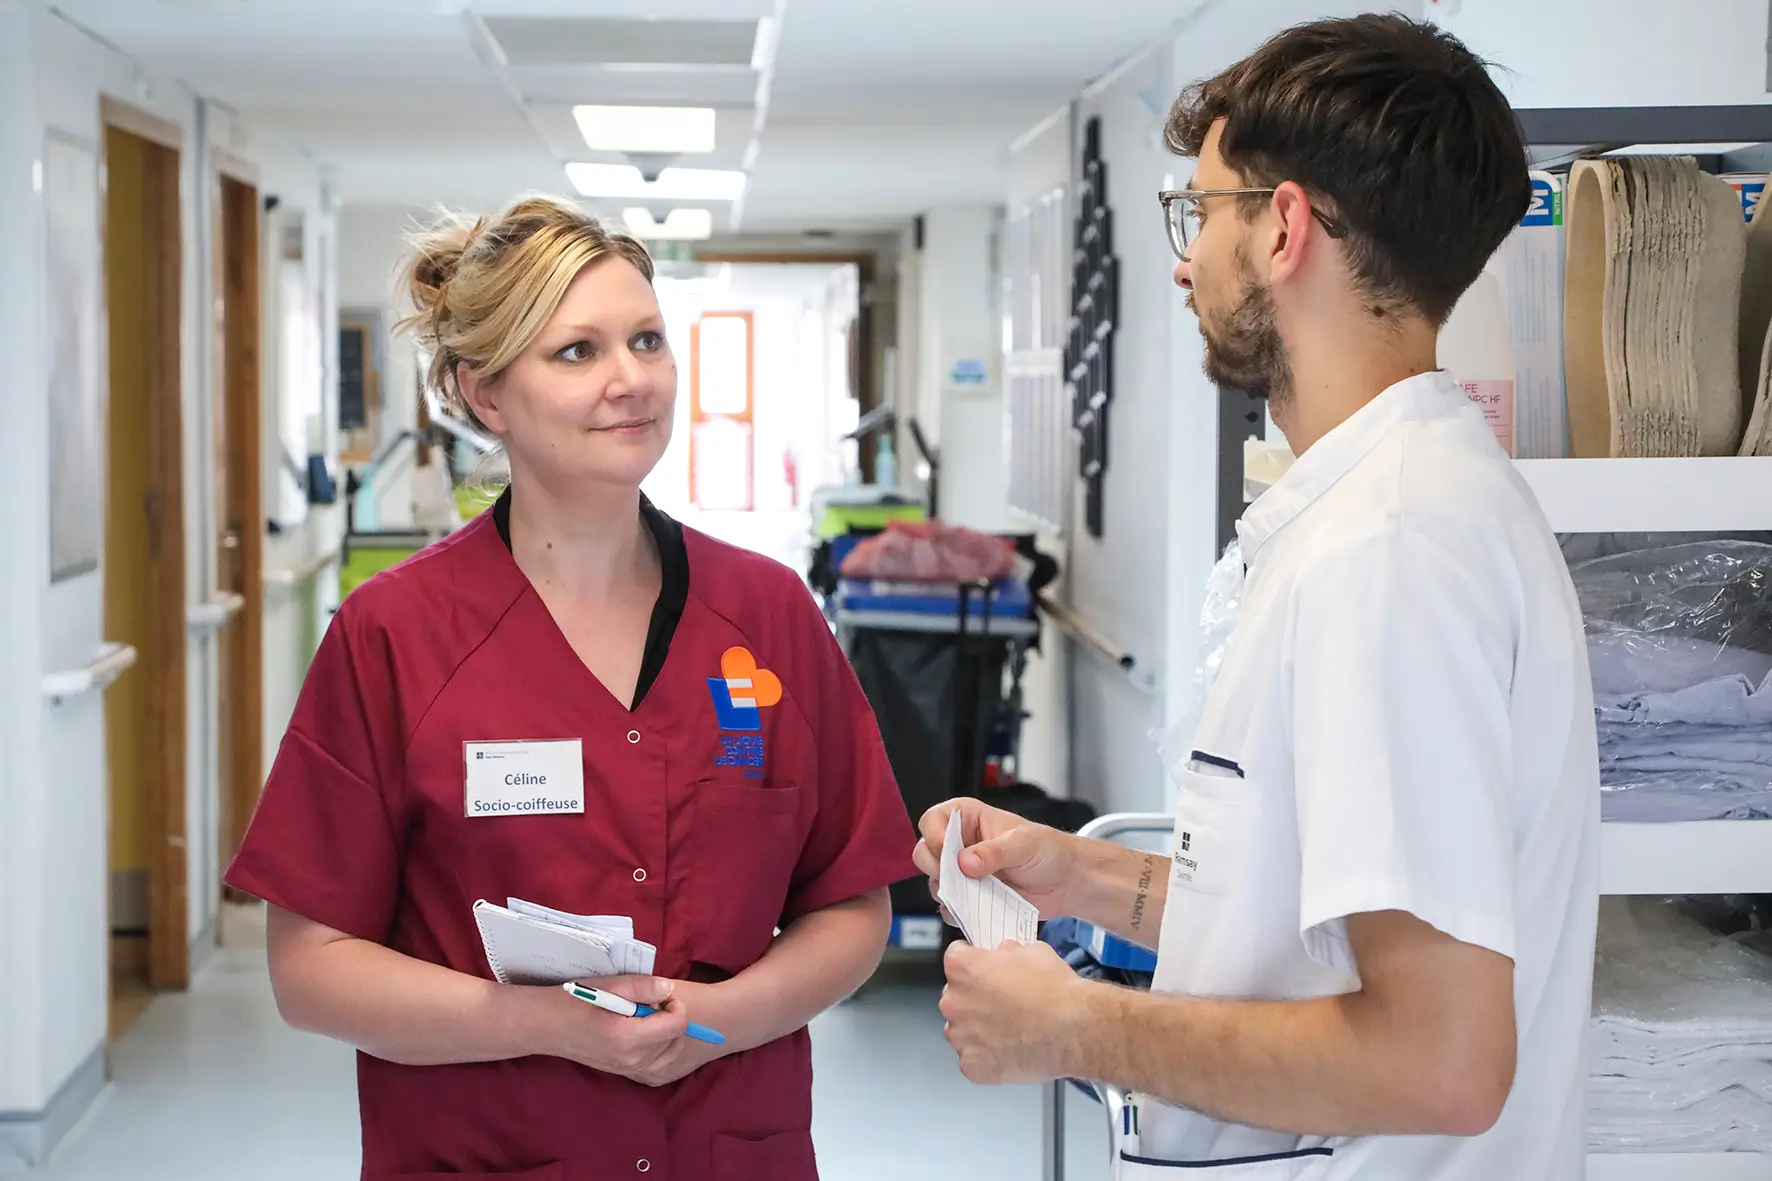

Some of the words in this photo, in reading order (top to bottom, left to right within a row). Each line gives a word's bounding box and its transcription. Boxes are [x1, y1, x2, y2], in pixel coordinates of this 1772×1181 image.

[1525, 188, 1549, 216] M
[1460, 383, 1478, 394] FE
[504, 772, 547, 786] Céline
[474, 797, 579, 812] Socio-coiffeuse
